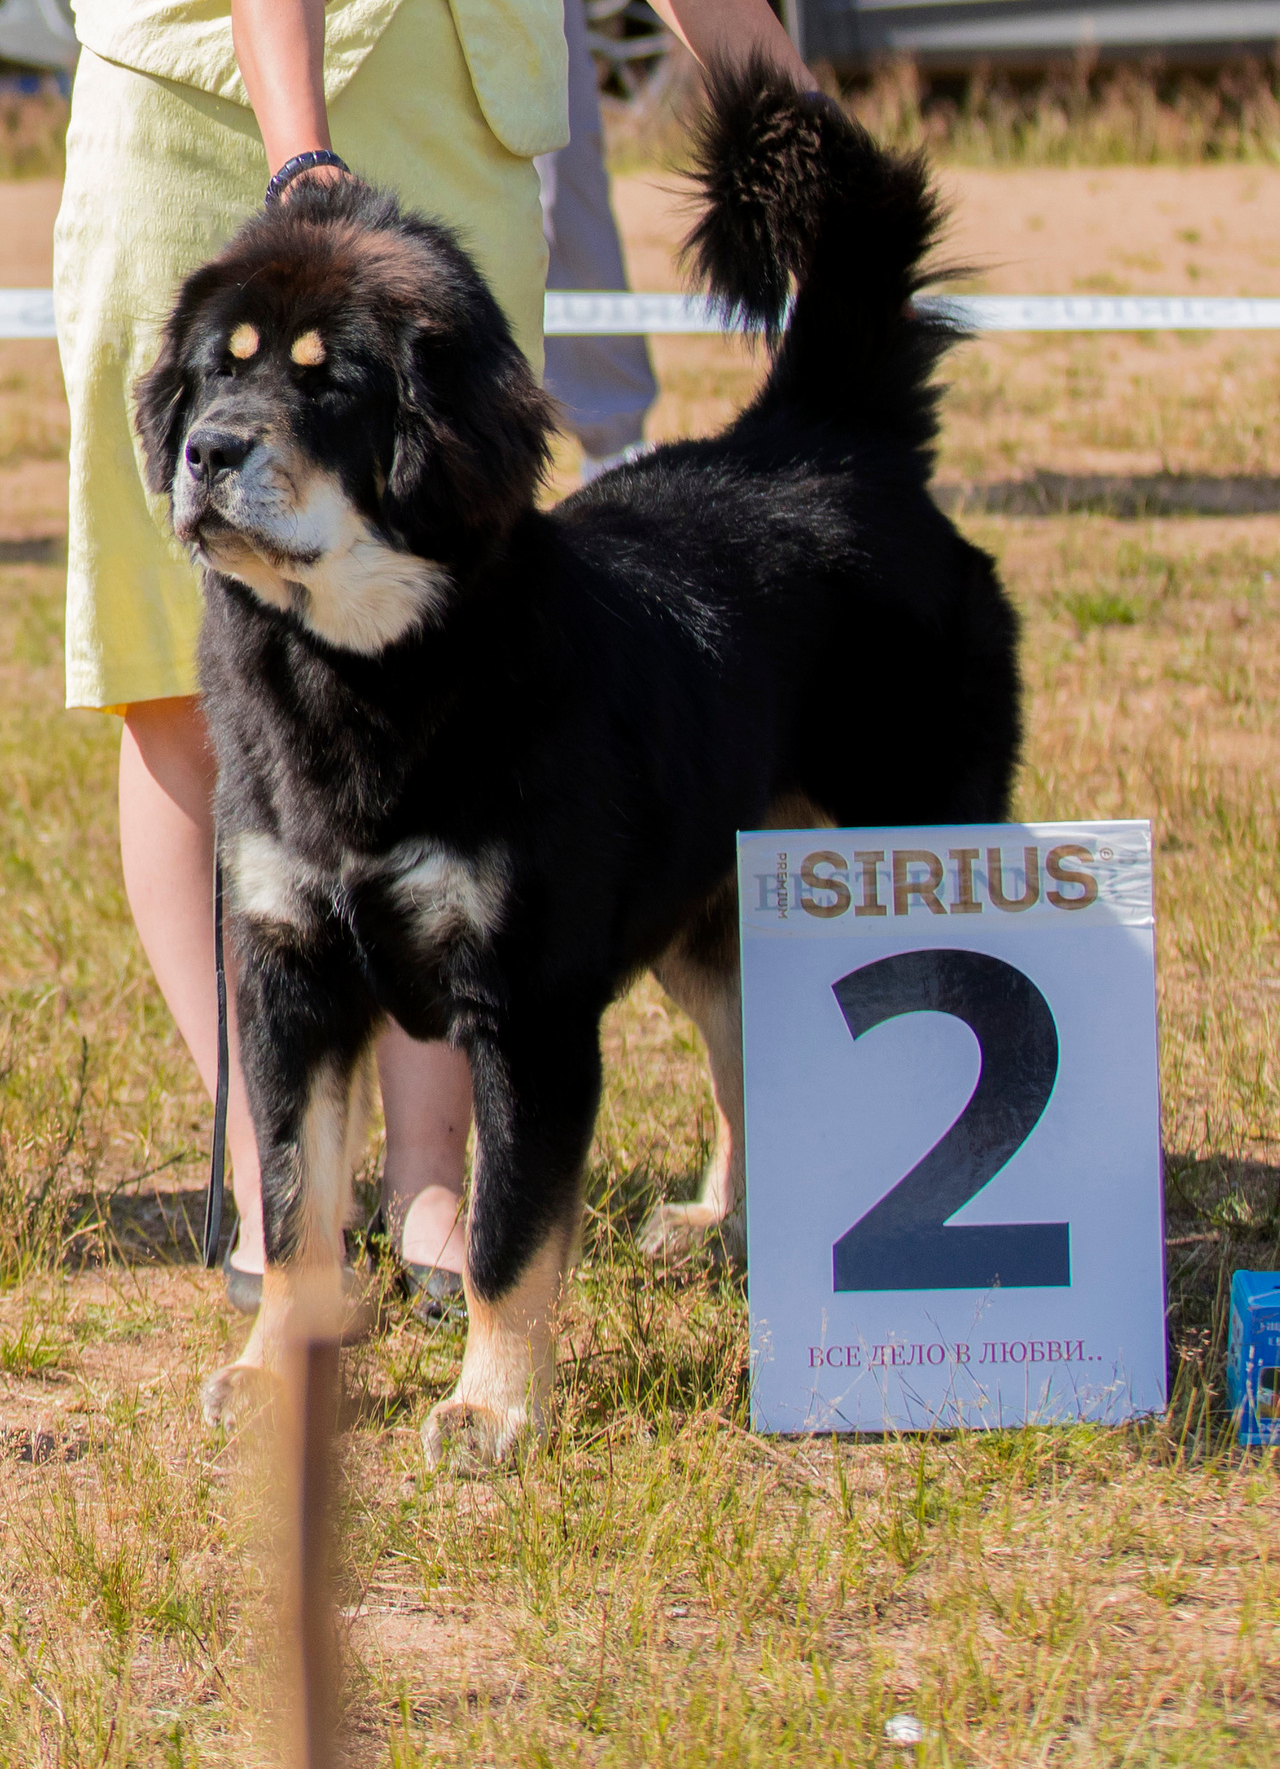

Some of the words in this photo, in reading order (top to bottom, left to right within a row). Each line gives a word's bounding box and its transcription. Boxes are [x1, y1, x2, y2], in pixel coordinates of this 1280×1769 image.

[776, 851, 789, 919] PREMIUM
[799, 843, 1099, 919] SIRIUS
[831, 948, 1071, 1293] 2
[807, 1345, 862, 1368] ВСЕ
[867, 1343, 946, 1372] ДЕЛО
[954, 1342, 971, 1364] В
